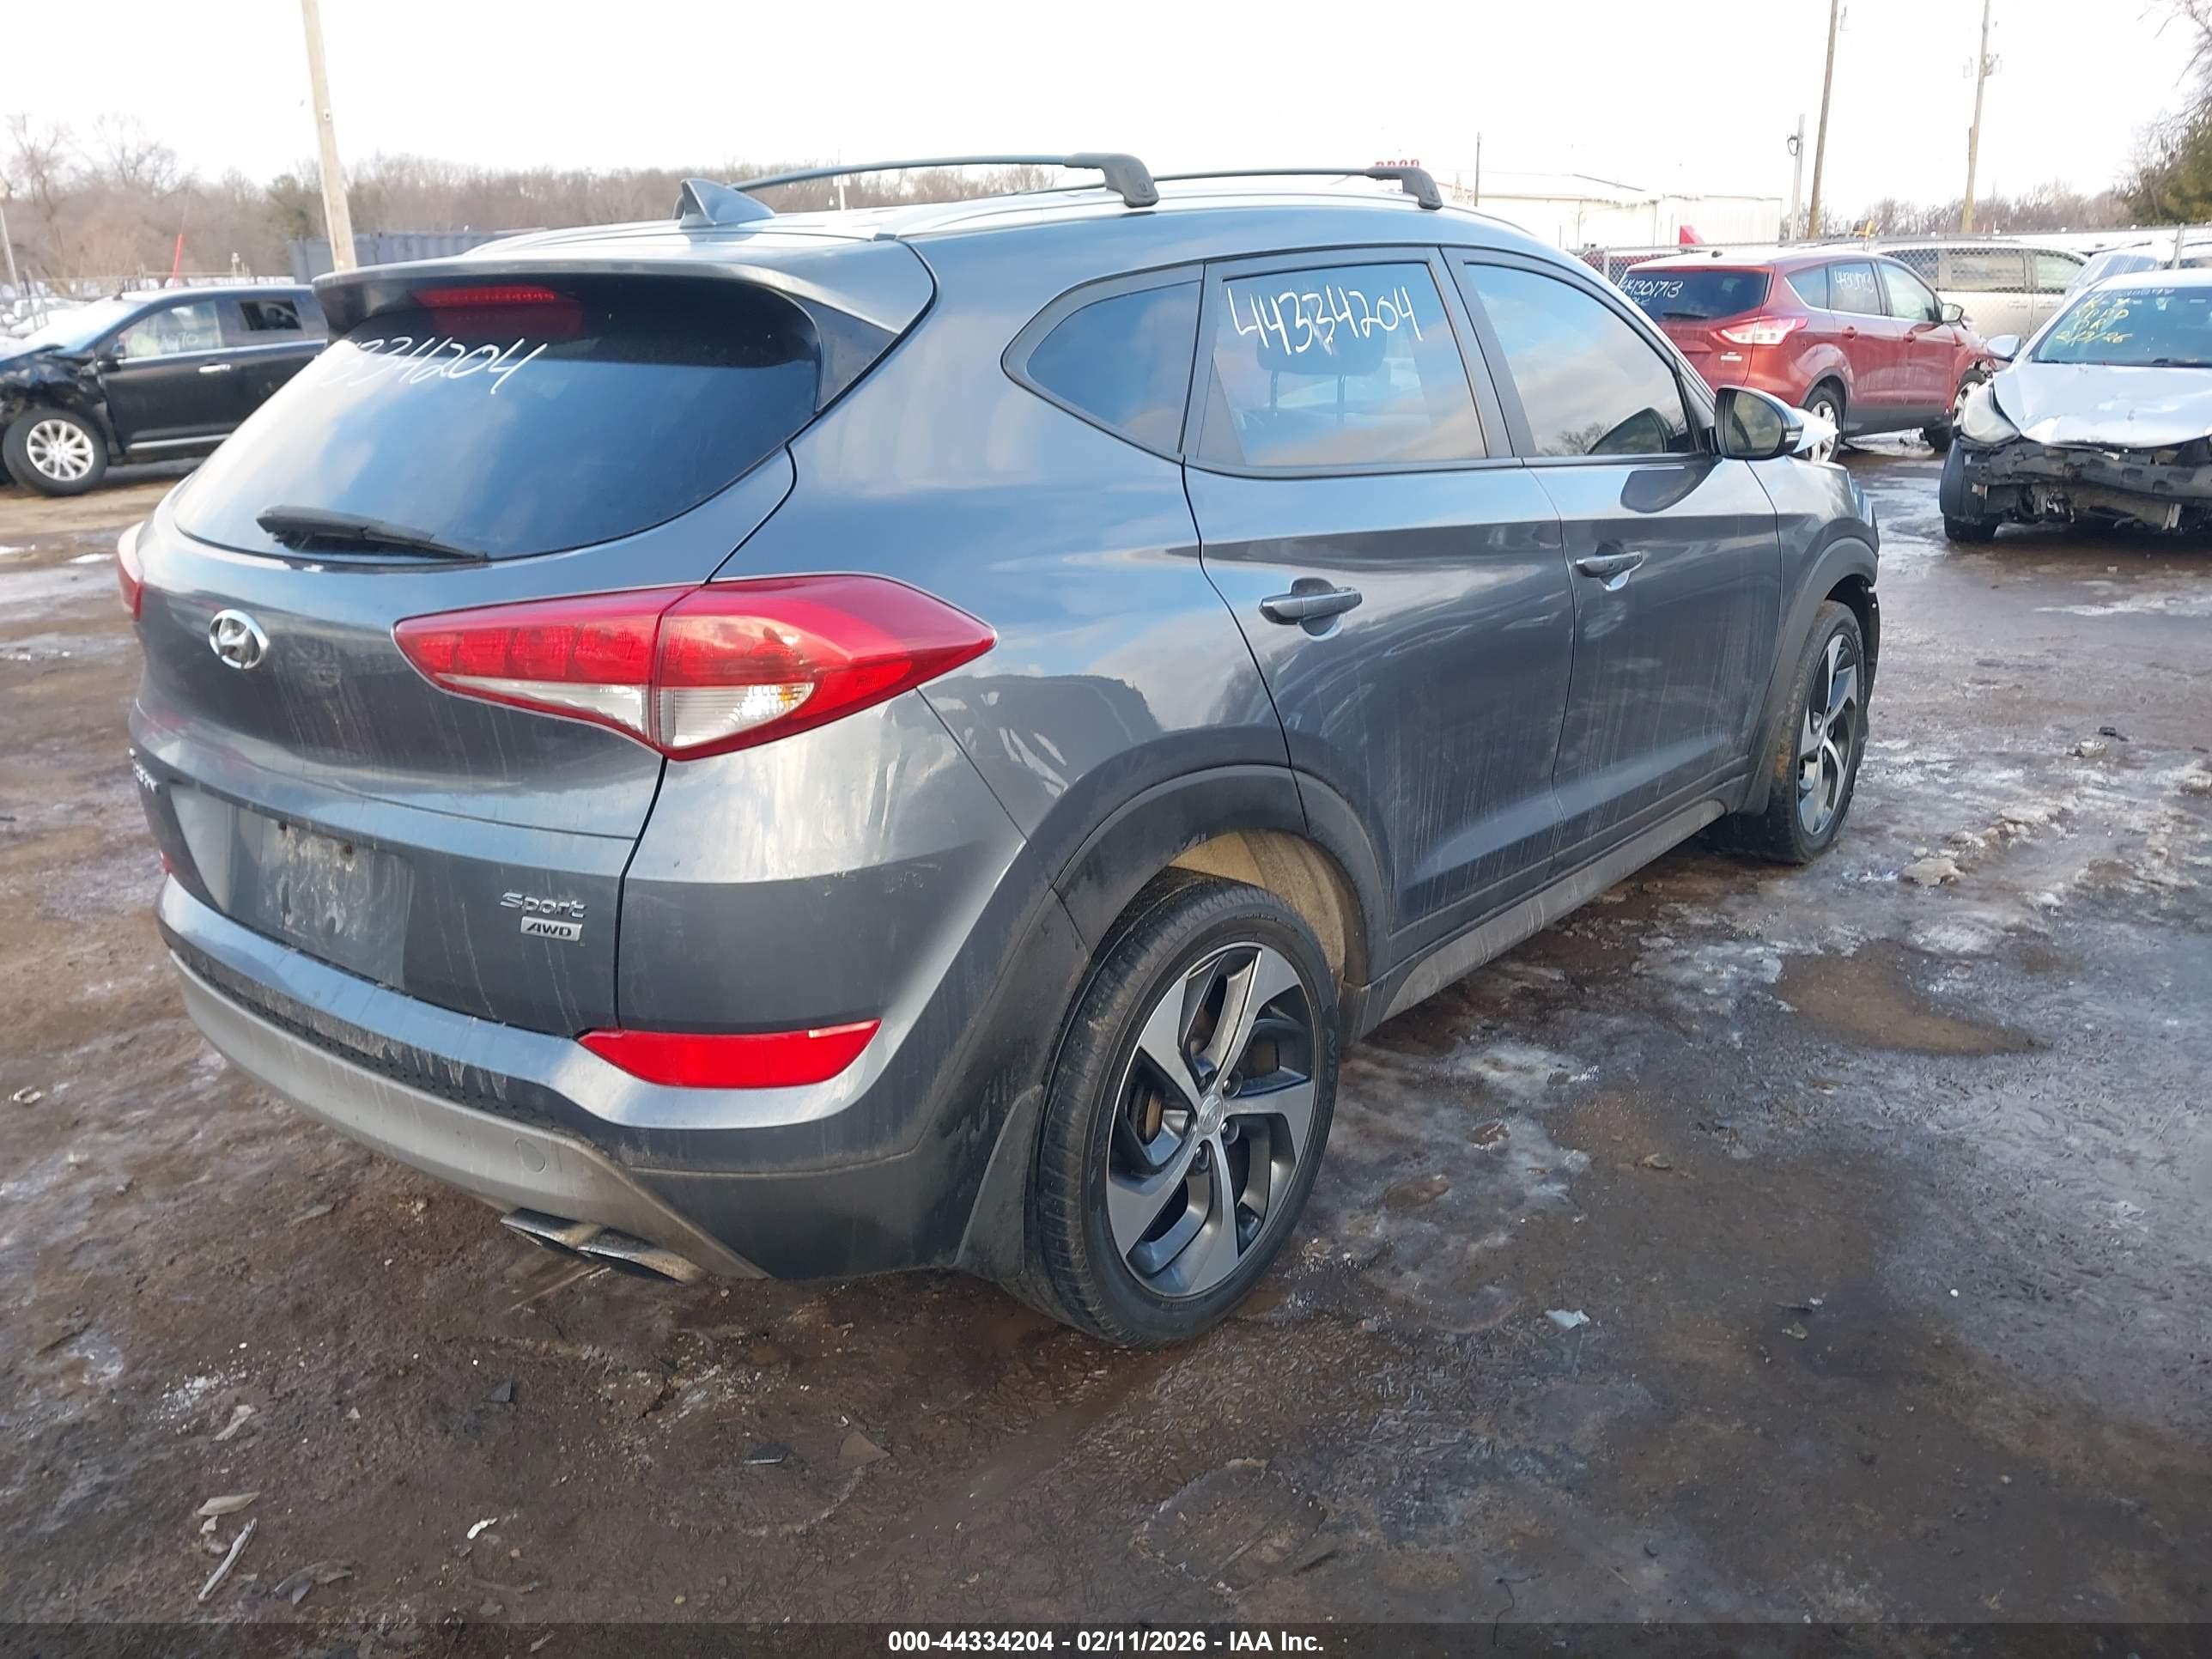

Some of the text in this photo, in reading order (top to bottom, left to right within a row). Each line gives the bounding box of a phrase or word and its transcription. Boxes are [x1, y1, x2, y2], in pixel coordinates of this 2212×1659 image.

[1227, 284, 1424, 356] 44334204
[321, 336, 547, 394] 334204
[526, 922, 573, 938] AWD
